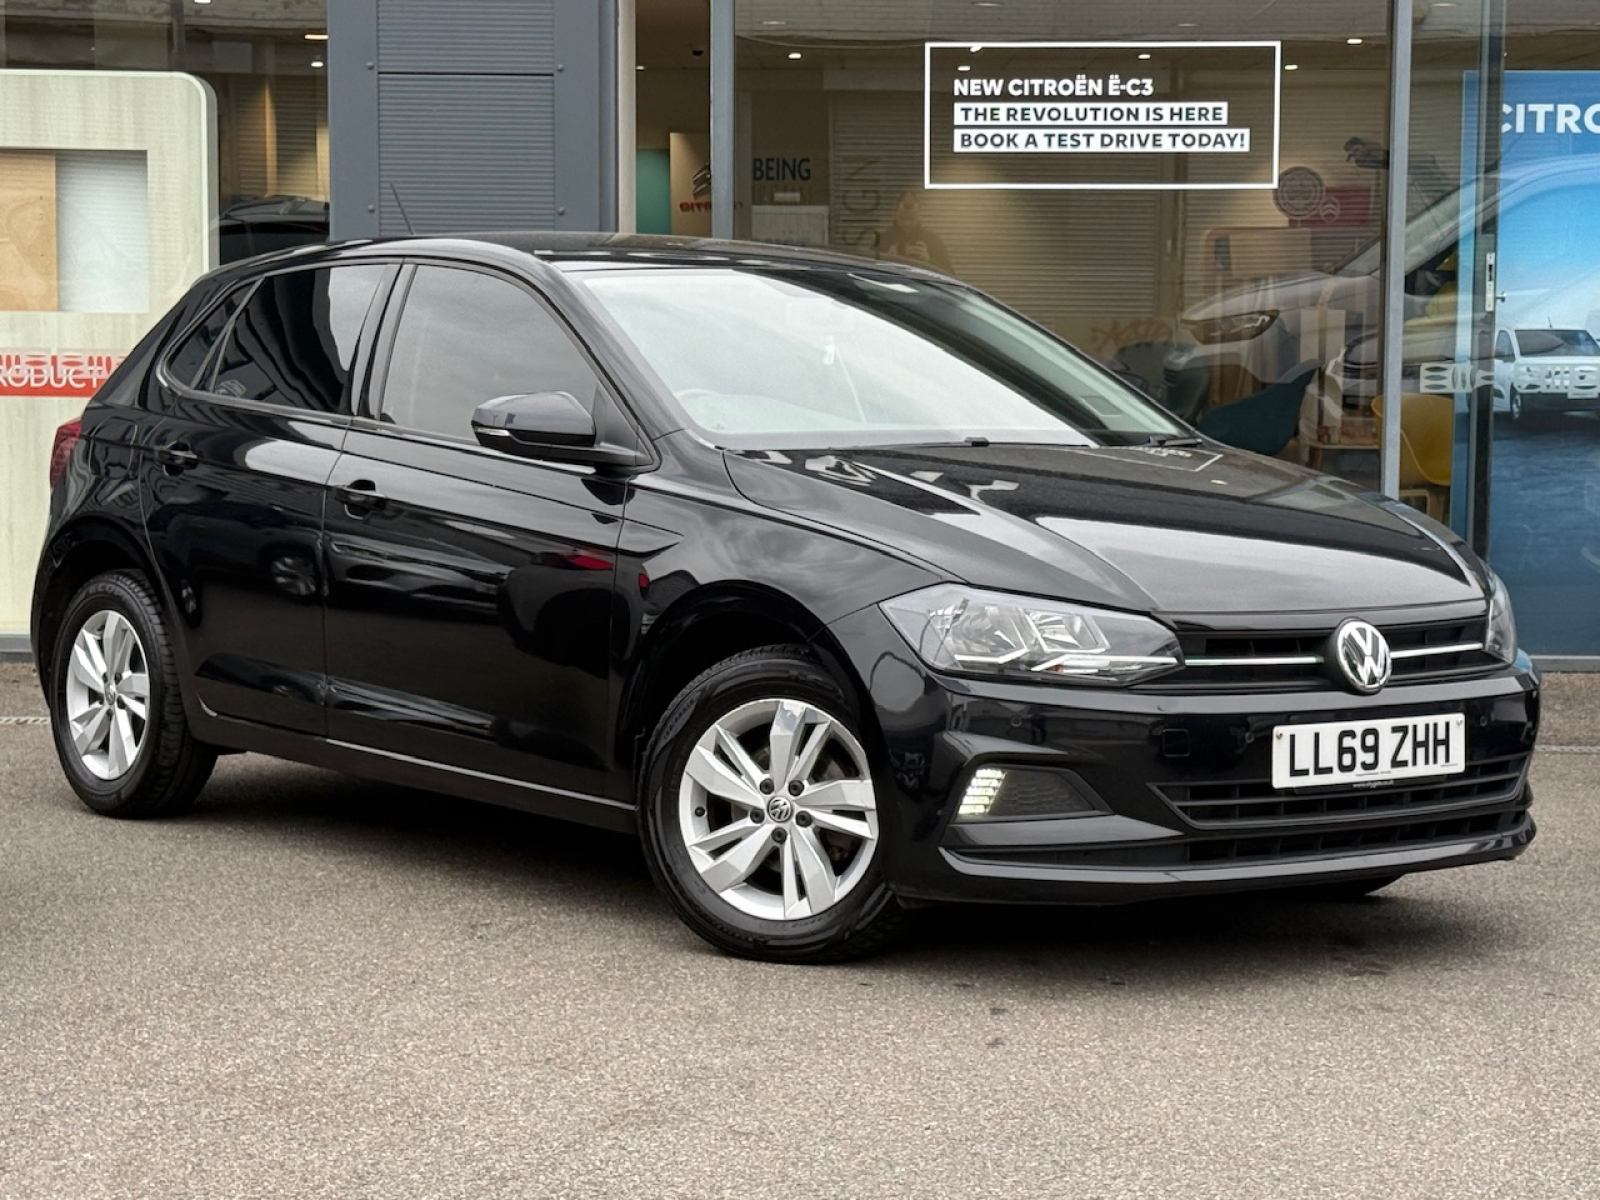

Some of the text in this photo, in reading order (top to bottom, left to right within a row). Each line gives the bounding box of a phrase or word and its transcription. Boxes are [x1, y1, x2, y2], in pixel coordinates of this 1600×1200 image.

[954, 75, 1153, 96] NEW CITROËN Ë-C3
[960, 107, 1222, 121] THE REVOLUTION IS HERE
[960, 133, 1245, 148] BOOK A TEST DRIVE TODAY!
[752, 157, 812, 182] BEING
[1289, 720, 1451, 778] LL69 ZHH
